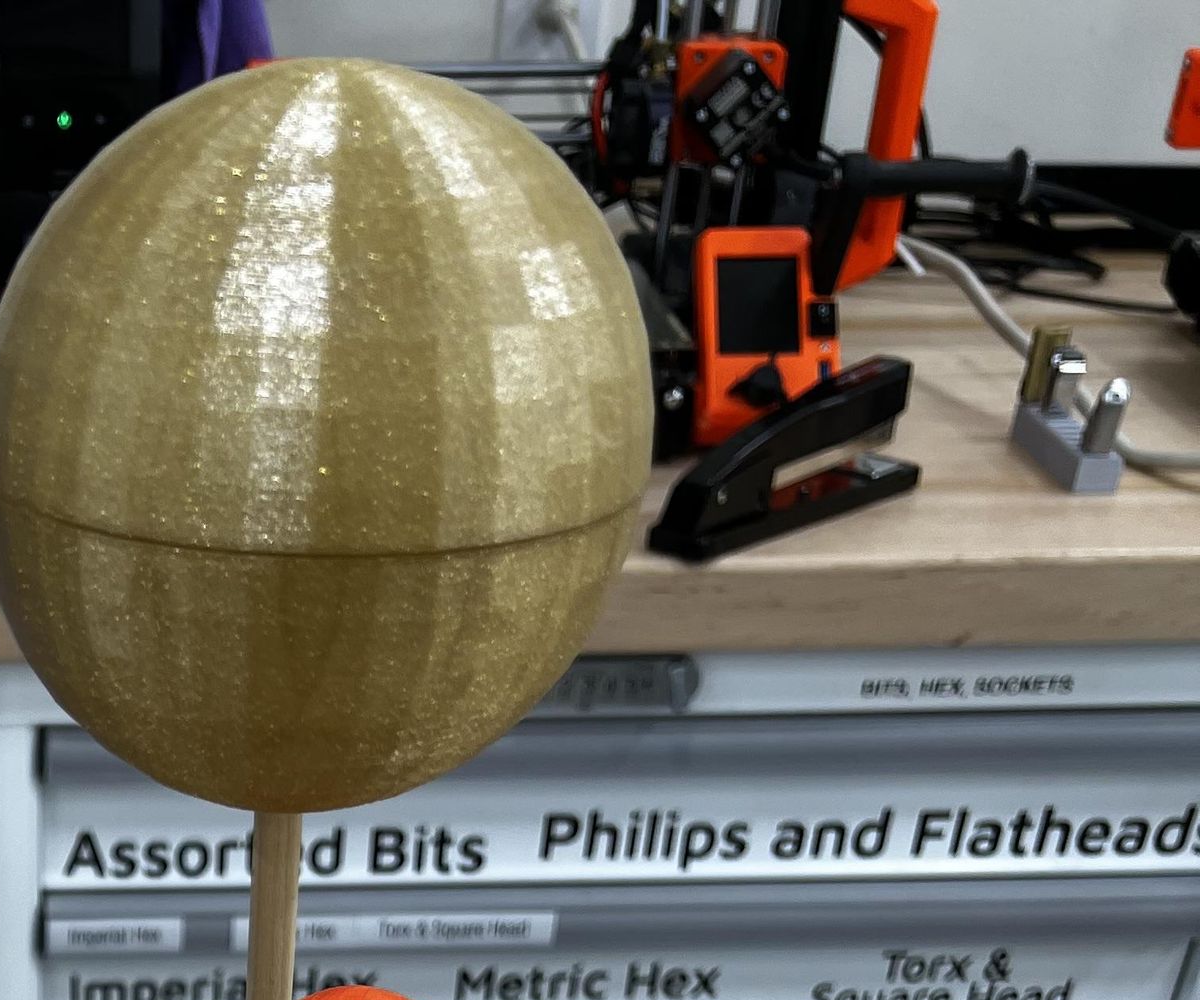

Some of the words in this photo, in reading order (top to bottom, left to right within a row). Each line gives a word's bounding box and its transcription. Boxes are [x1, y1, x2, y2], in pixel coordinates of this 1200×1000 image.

[366, 823, 489, 875] Bits
[770, 805, 894, 861] and
[624, 959, 722, 1000] Hex
[882, 949, 974, 984] Torx
[983, 947, 1012, 982] &
